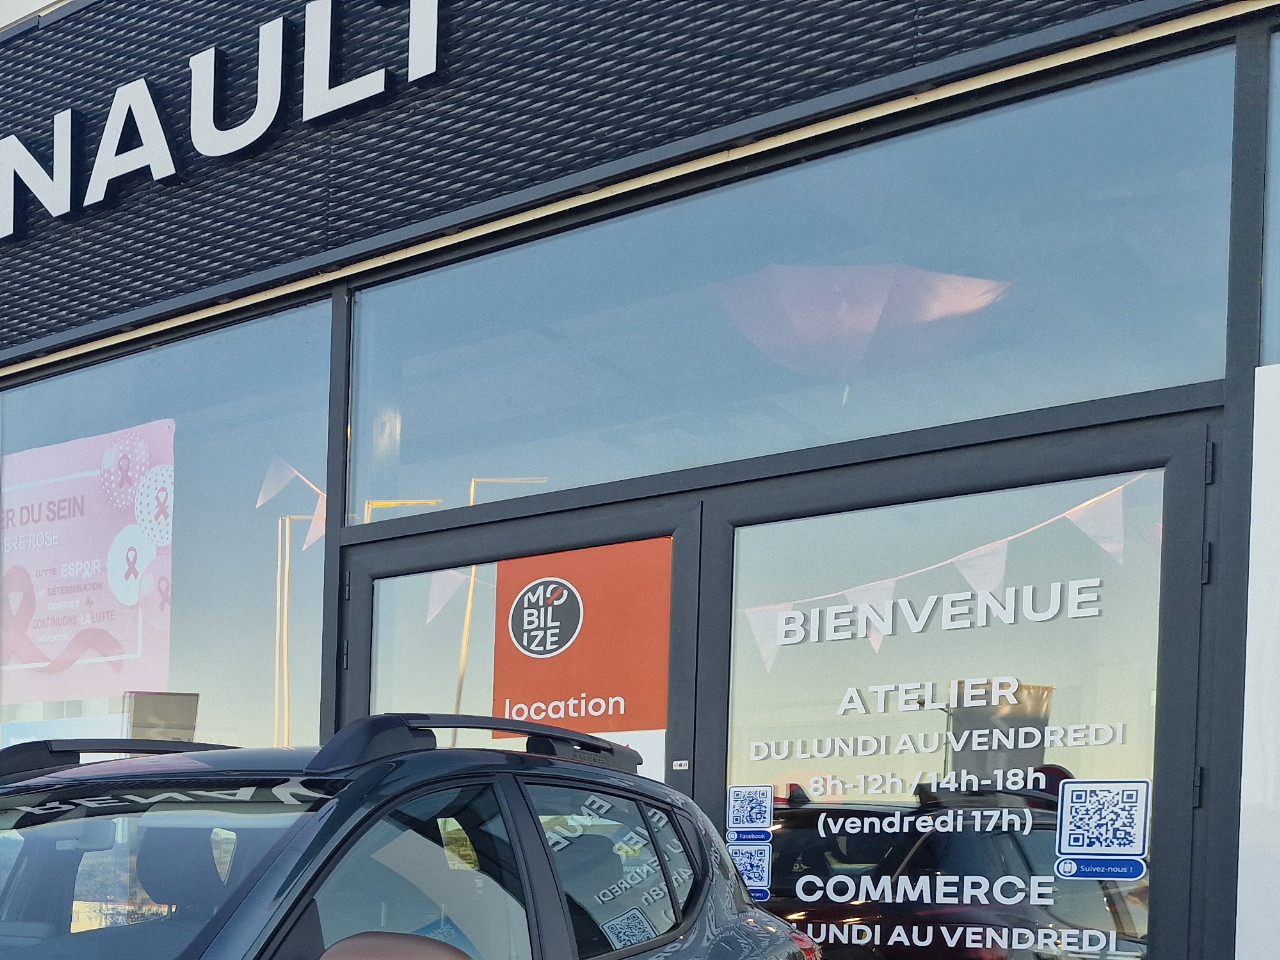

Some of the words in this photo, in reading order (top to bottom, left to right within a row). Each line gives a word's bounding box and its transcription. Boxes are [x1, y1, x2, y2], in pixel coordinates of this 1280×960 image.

[20, 503, 42, 526] DU
[46, 495, 85, 522] SEIN
[29, 529, 59, 548] ROSE
[776, 577, 1102, 646] BIENVENUE
[505, 693, 625, 720] location
[837, 675, 1020, 715] ATELIER
[750, 740, 789, 761] DU
[797, 734, 887, 759] LUNDI
[894, 732, 942, 754] AU
[946, 723, 1127, 752] VENDREDI
[809, 771, 904, 796] 8h-12h
[928, 767, 1047, 793] 14h-18h
[817, 809, 963, 837] (vendredi
[971, 808, 1034, 836] 17h)
[1080, 865, 1128, 873] Suivez-nous
[795, 874, 1055, 906] COMMERCE
[887, 925, 933, 947] AU
[940, 926, 1117, 953] VENDREDI
